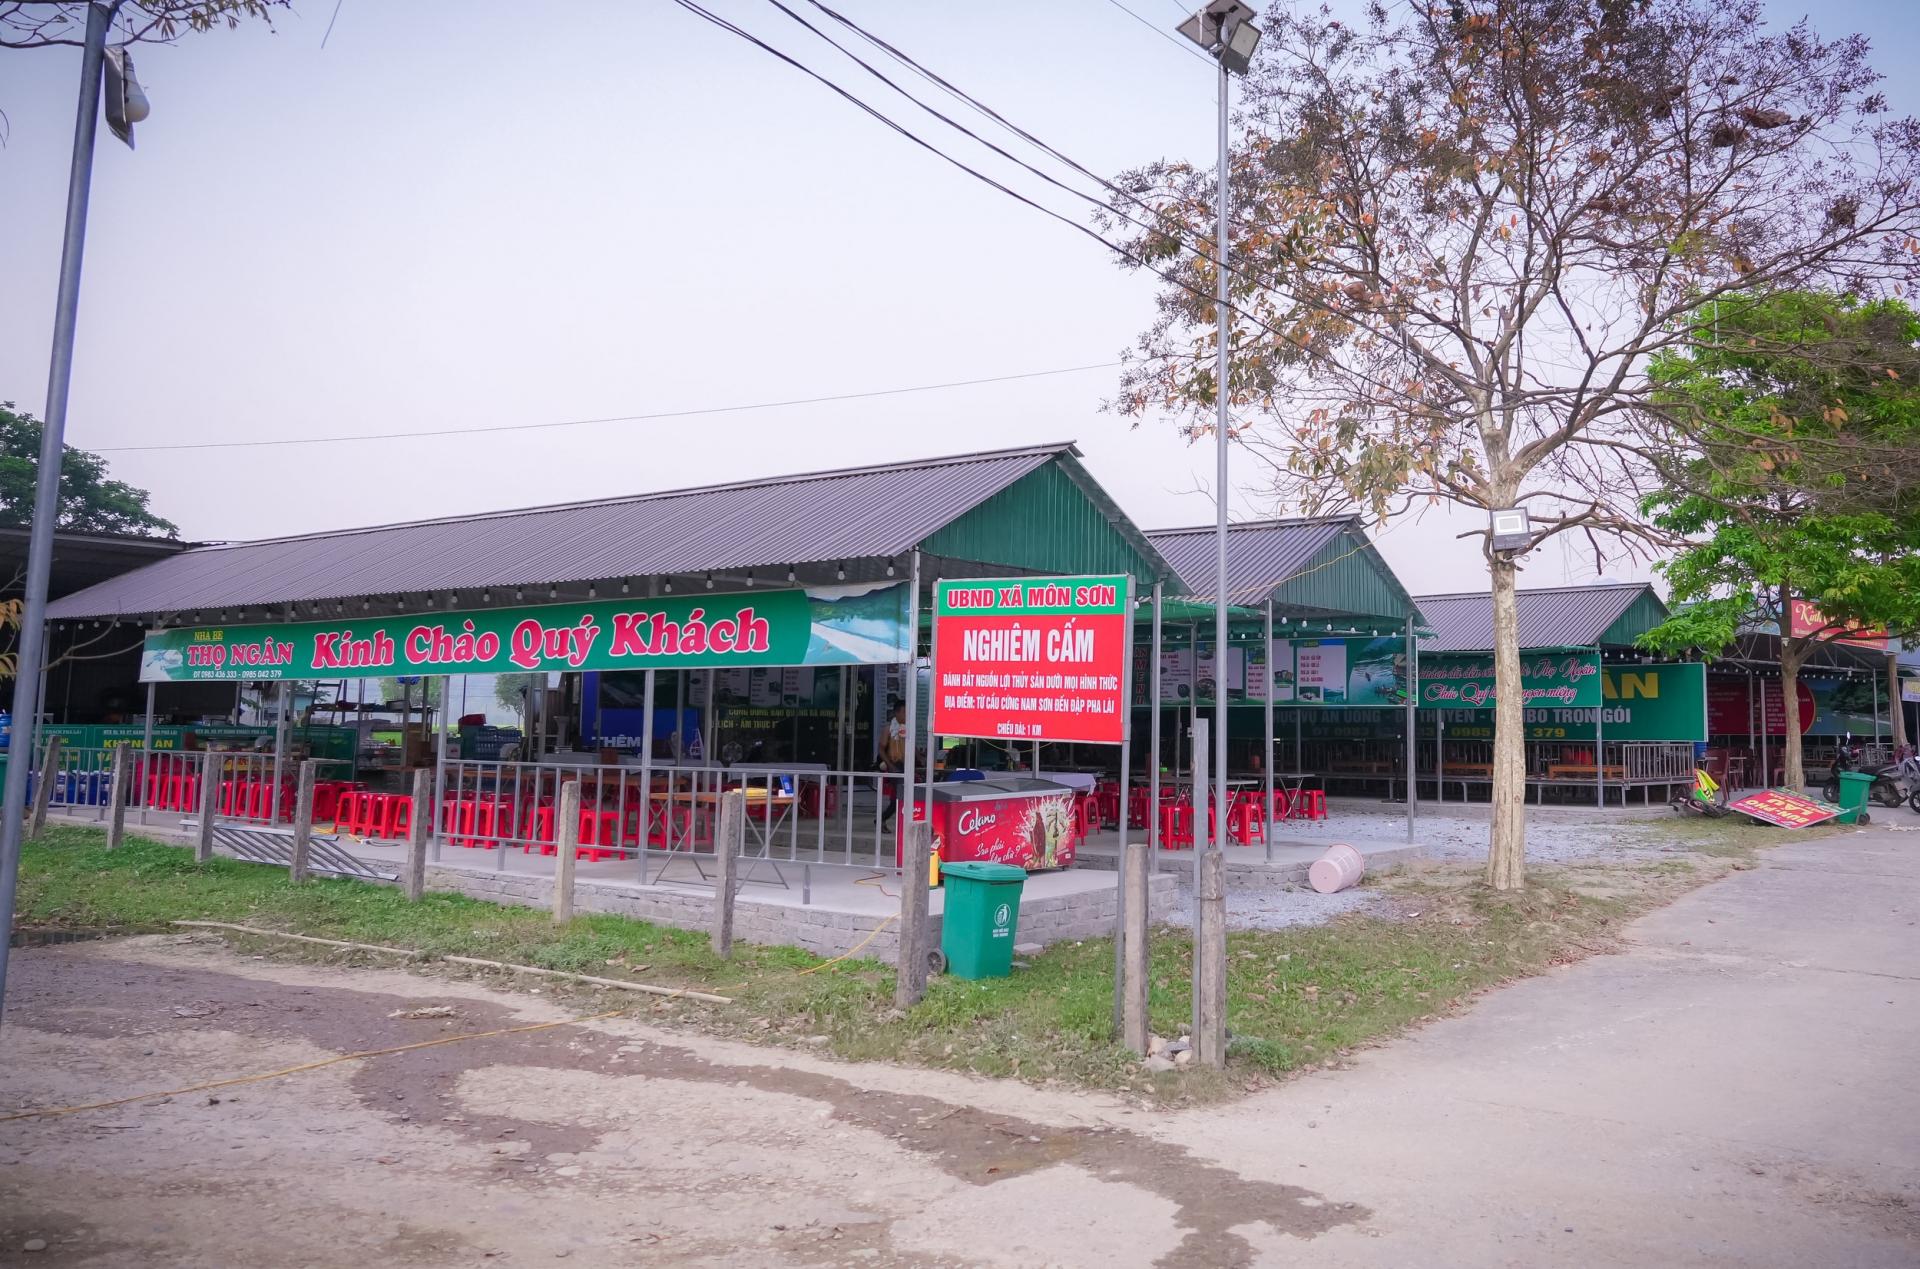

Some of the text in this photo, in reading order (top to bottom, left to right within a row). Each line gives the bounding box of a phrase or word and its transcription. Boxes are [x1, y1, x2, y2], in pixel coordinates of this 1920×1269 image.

[947, 582, 1116, 609] UBND XÃ MÔN SƠN
[311, 608, 770, 669] Kính Chào Quý Khách
[963, 617, 1095, 662] NGHIÊM CẤM
[187, 636, 294, 670] THỌ NGÂN
[270, 670, 282, 678] 379
[943, 672, 961, 687] ĐÁNH
[962, 669, 975, 687] BẮT
[1000, 673, 1011, 691] LỢI
[1030, 671, 1045, 689] SẢN
[1064, 675, 1078, 692] MỌI
[1080, 673, 1097, 690] HÌNH
[1099, 673, 1118, 690] THỨC
[1559, 657, 1597, 683] Ngân
[1021, 697, 1037, 711] NAM
[1038, 697, 1053, 712] SƠN
[1054, 694, 1069, 712] ĐẾN
[1103, 697, 1115, 714] LÀI
[1460, 682, 1491, 706] Quý
[1546, 684, 1577, 705] miệng
[1552, 709, 1598, 727] TRỌN
[1602, 705, 1632, 724] GÓI
[592, 734, 641, 748] THÊM
[1027, 724, 1031, 736] 1
[1031, 724, 1042, 736] KM
[1533, 728, 1566, 737] 379
[958, 808, 997, 836] Celano
[975, 843, 989, 857] Sao
